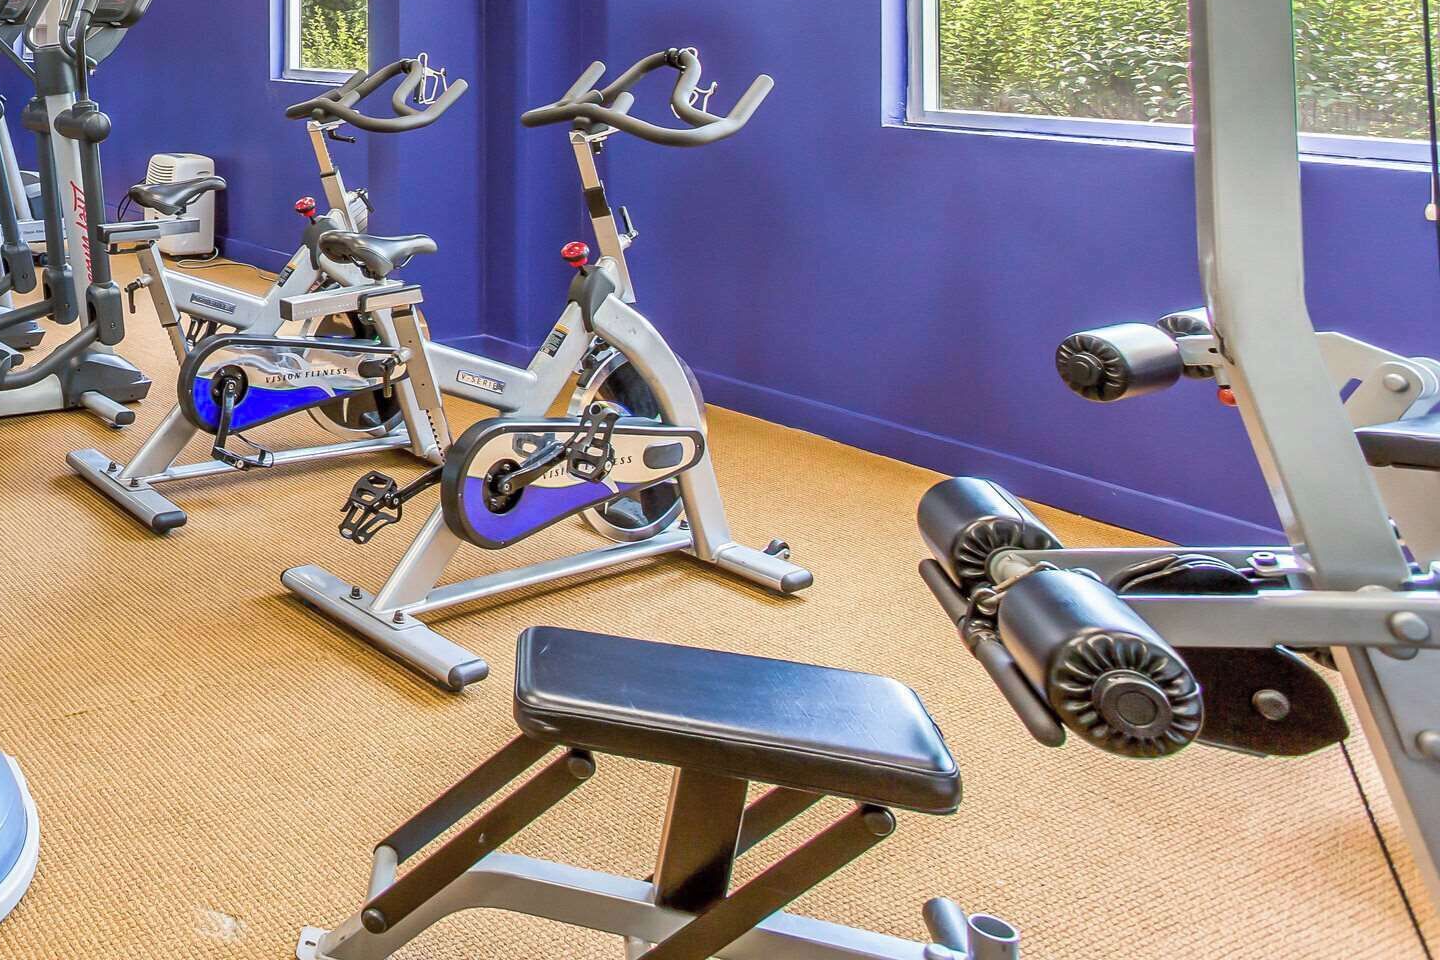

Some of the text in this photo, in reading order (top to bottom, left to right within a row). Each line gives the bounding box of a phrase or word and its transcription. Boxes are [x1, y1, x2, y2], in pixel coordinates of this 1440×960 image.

[265, 367, 348, 384] VISION FITNESS
[460, 373, 505, 390] V-SERIE
